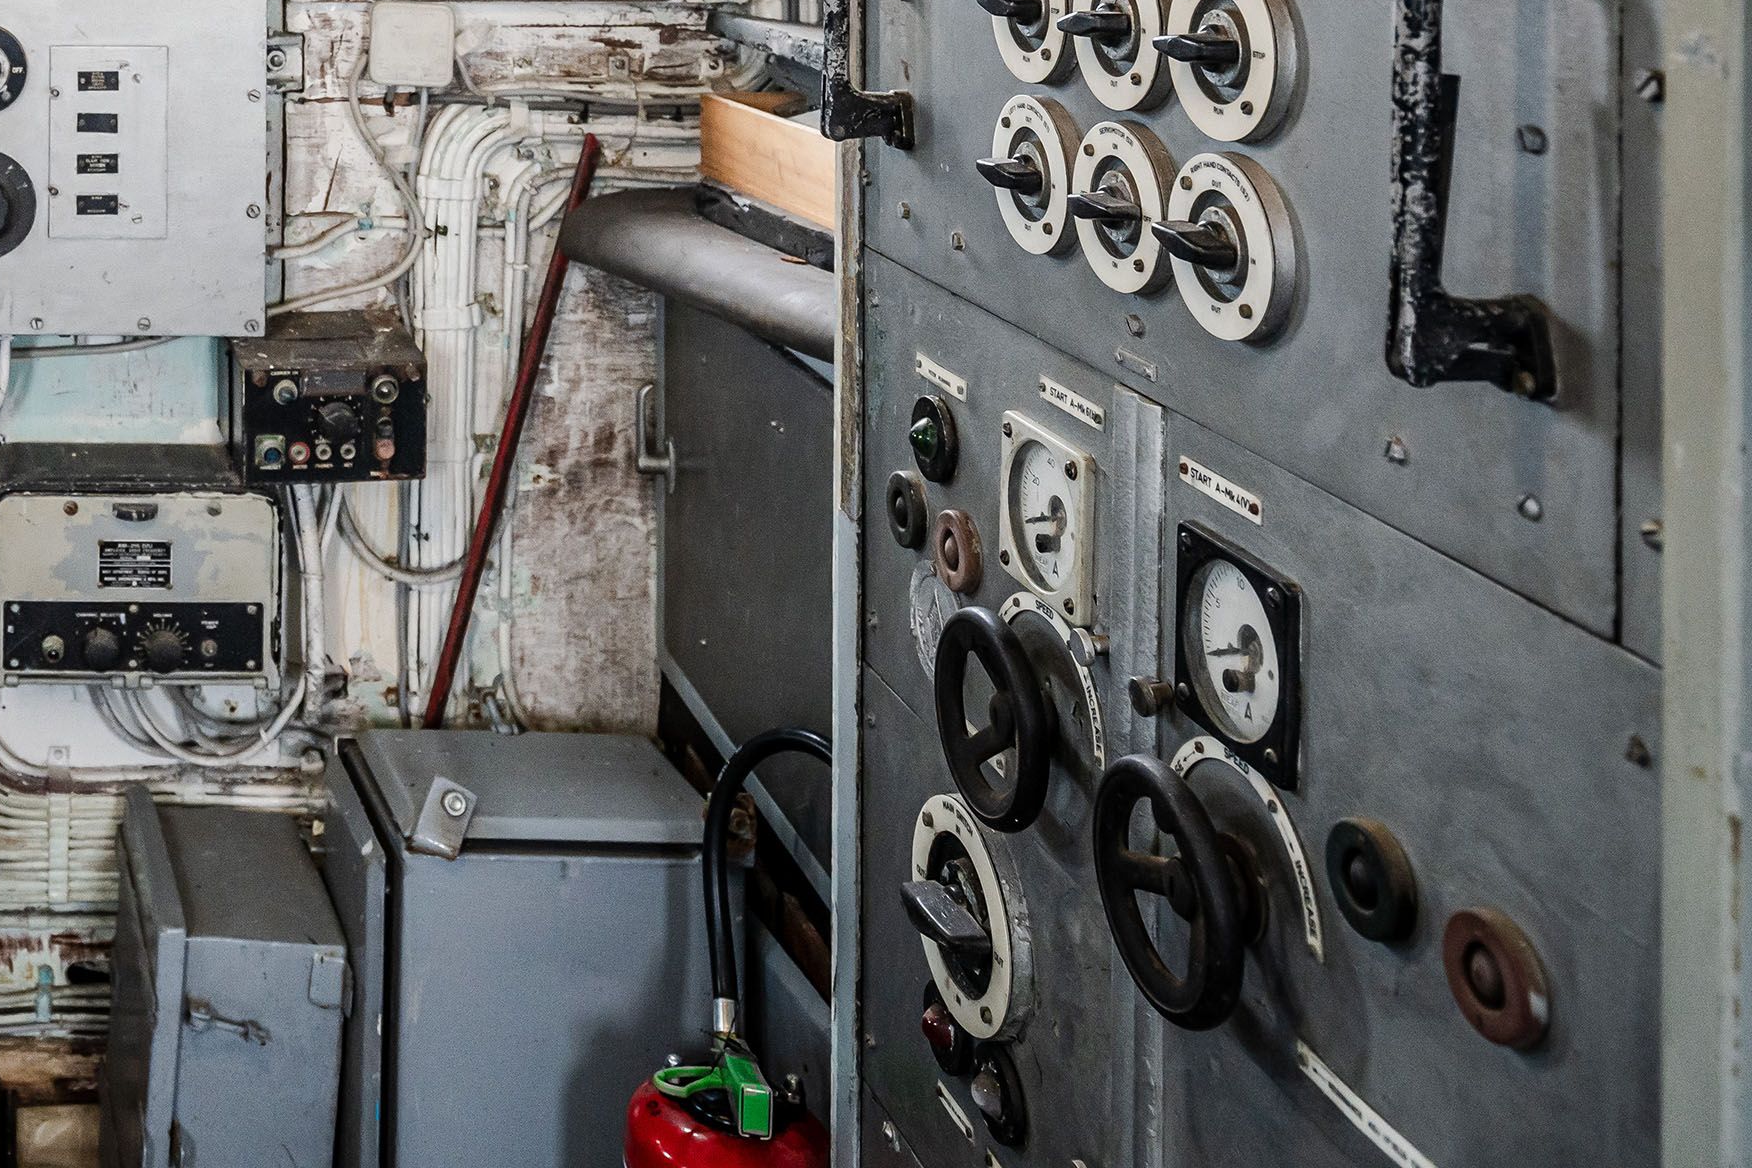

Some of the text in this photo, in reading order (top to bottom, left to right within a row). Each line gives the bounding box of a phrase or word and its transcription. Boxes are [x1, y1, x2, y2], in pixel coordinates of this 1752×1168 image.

[1252, 51, 1266, 60] STOP
[1213, 106, 1225, 116] RUN
[1190, 162, 1203, 174] RIGHT
[1203, 161, 1217, 169] HAND
[1216, 163, 1241, 188] CONTACTS
[1211, 179, 1222, 189] OUT
[1210, 304, 1222, 315] OUT
[1049, 386, 1067, 404] START
[1031, 476, 1041, 487] 20
[1190, 467, 1212, 489] START
[1052, 559, 1060, 578] A
[1235, 575, 1246, 590] 10
[1034, 599, 1054, 620] SPEED
[1214, 596, 1222, 610] 5
[1085, 684, 1103, 755] INCREASE
[1243, 701, 1253, 723] A
[1223, 746, 1250, 774] SPEED
[941, 800, 954, 813] MAIN
[1295, 860, 1317, 938] INCREASE
